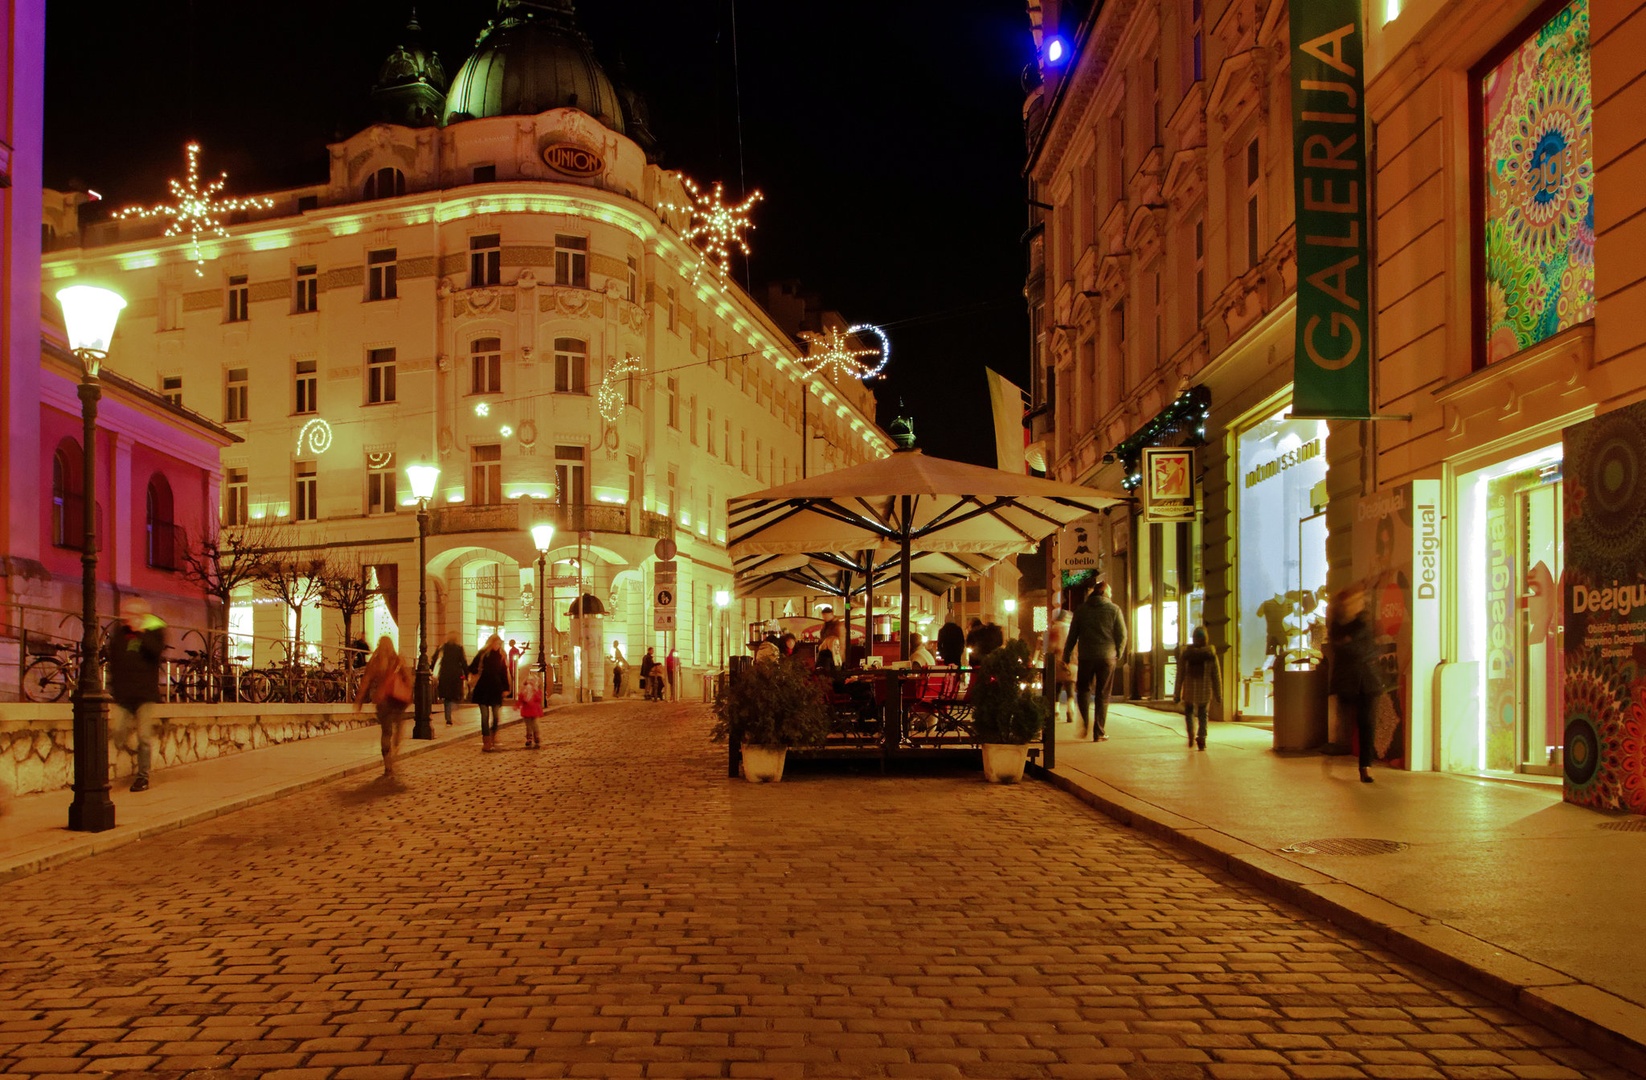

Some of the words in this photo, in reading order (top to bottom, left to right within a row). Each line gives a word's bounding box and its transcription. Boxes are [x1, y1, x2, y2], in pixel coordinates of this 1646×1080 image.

[552, 148, 598, 171] UNION
[1490, 134, 1592, 216] Desigua
[1299, 22, 1361, 371] GALERIJA
[1358, 488, 1405, 522] Desigual
[1064, 557, 1095, 566] Cobello
[1417, 503, 1440, 600] Desigual
[1488, 506, 1510, 680] Desigual
[1573, 579, 1646, 616] Desigu
